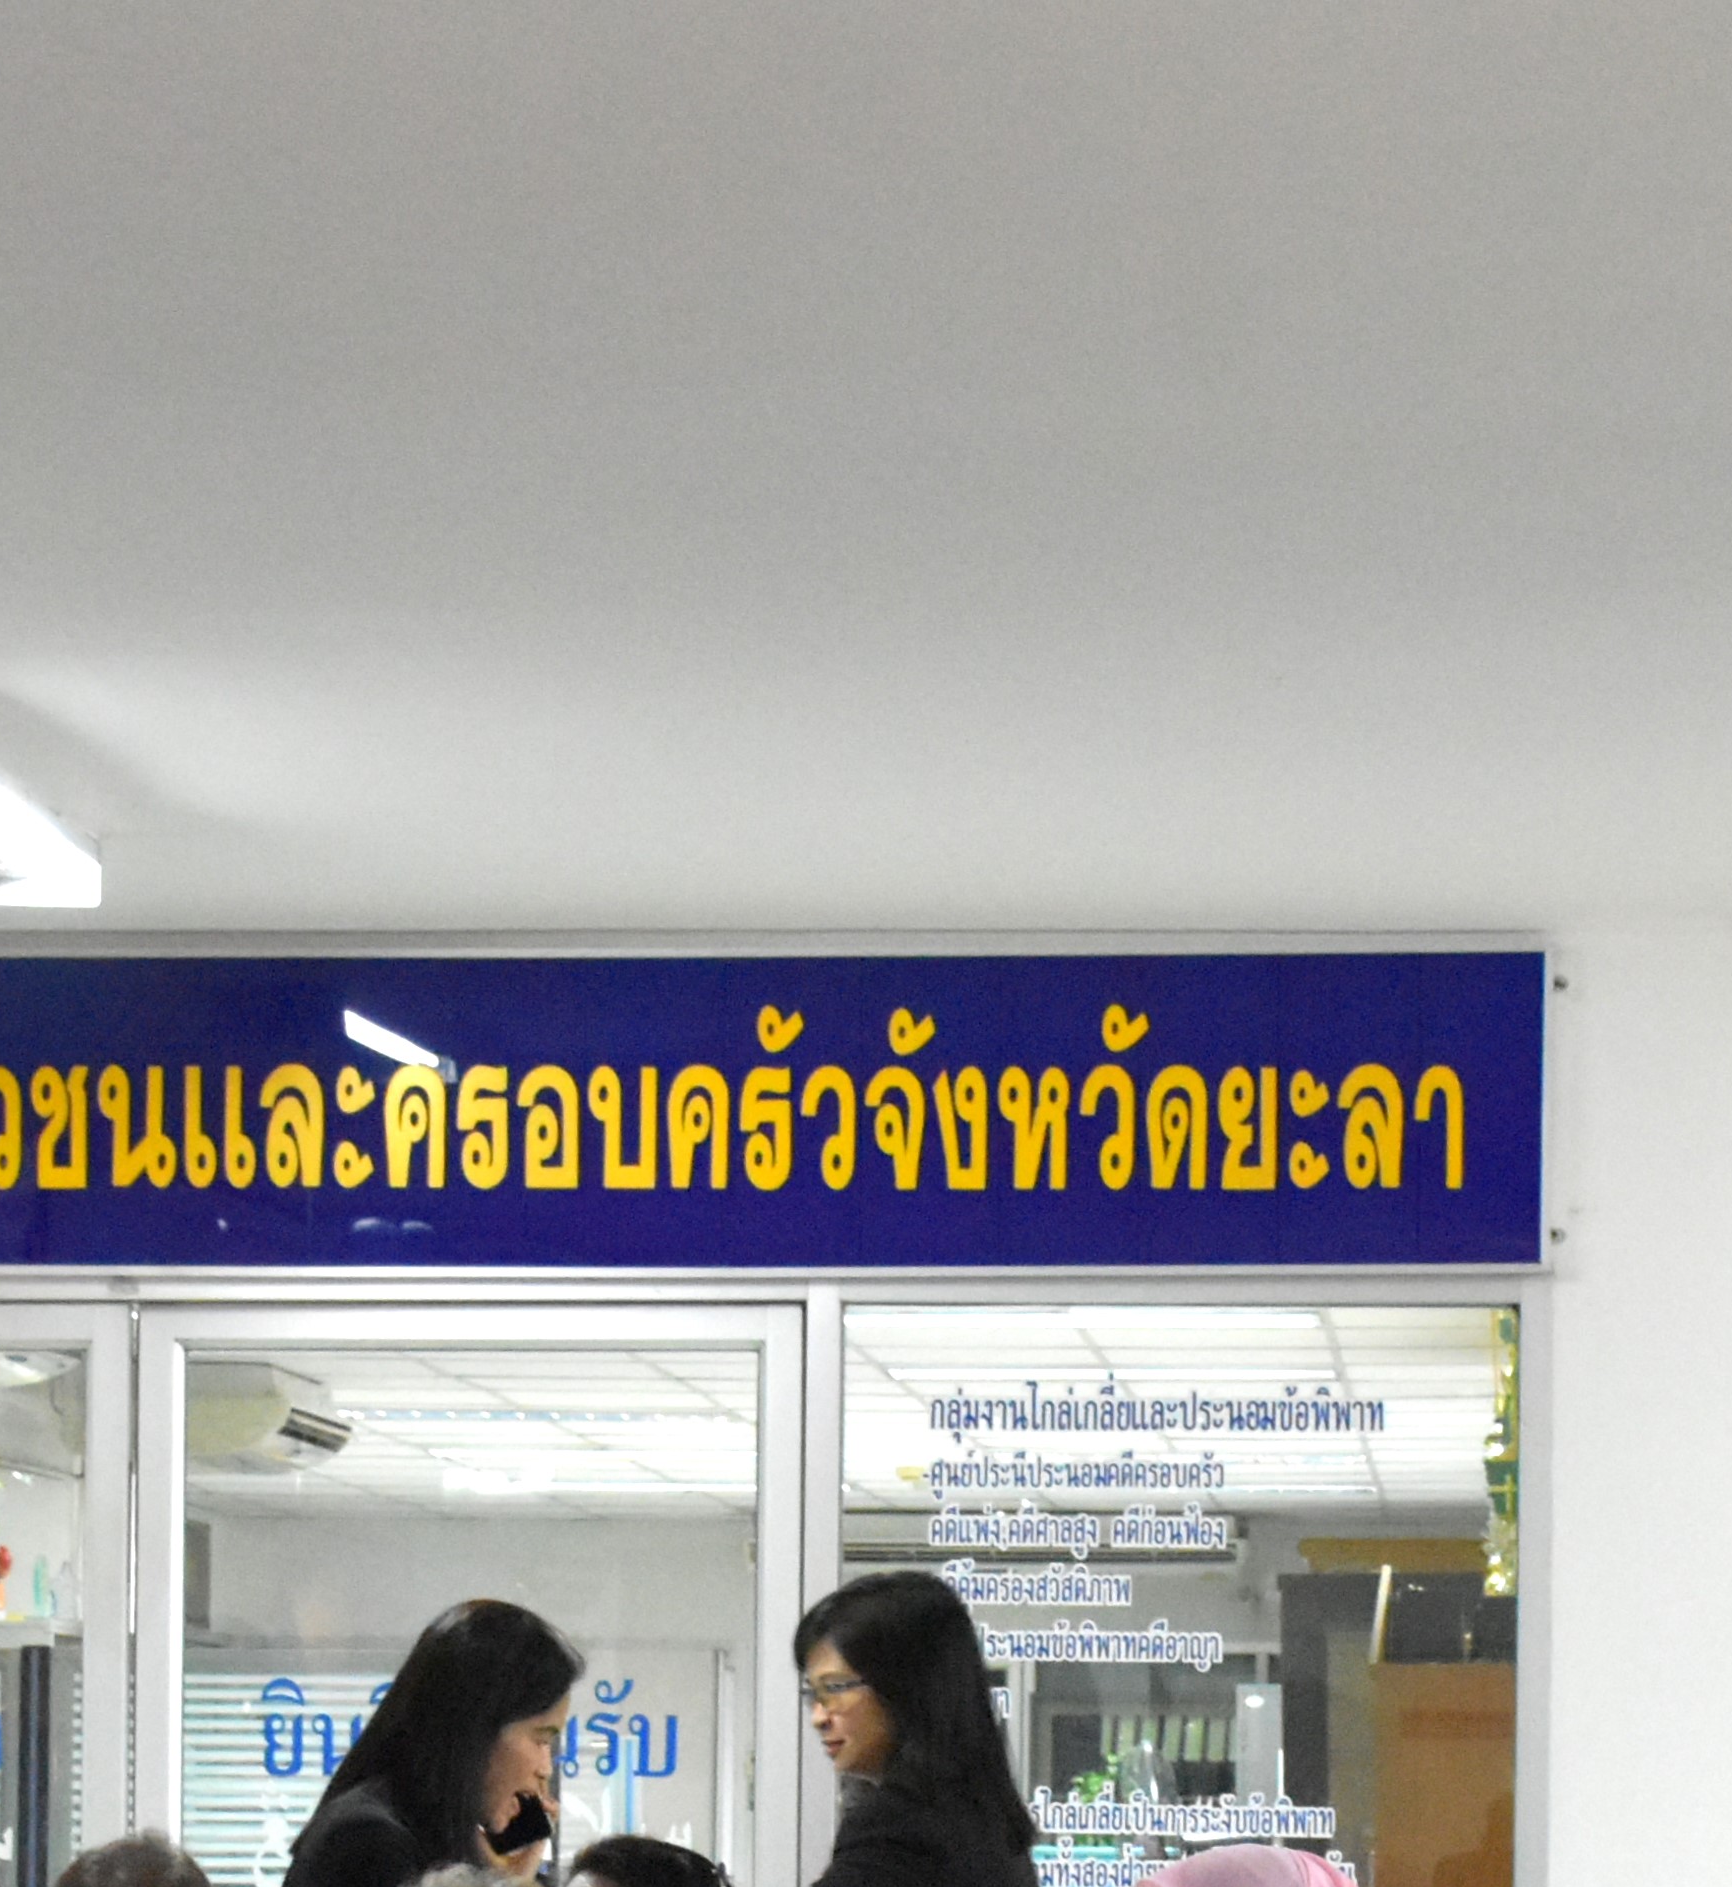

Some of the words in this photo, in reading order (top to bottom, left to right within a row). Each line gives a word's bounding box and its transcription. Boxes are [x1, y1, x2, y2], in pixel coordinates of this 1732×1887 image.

[930, 1373, 1385, 1444] กลุ่มงานไกล่เกลี่ยและประนอมข้อพิพาท
[1113, 1503, 1225, 1547] คดีก่อนฟ้อง
[979, 1620, 1222, 1672] ระนอมข้อพิพาทคดีอาญา
[262, 1677, 678, 1778] ยินนรับ
[1030, 1784, 1335, 1833] รไกล่เกลี่ยเป็นการระงับข้อพิพาท
